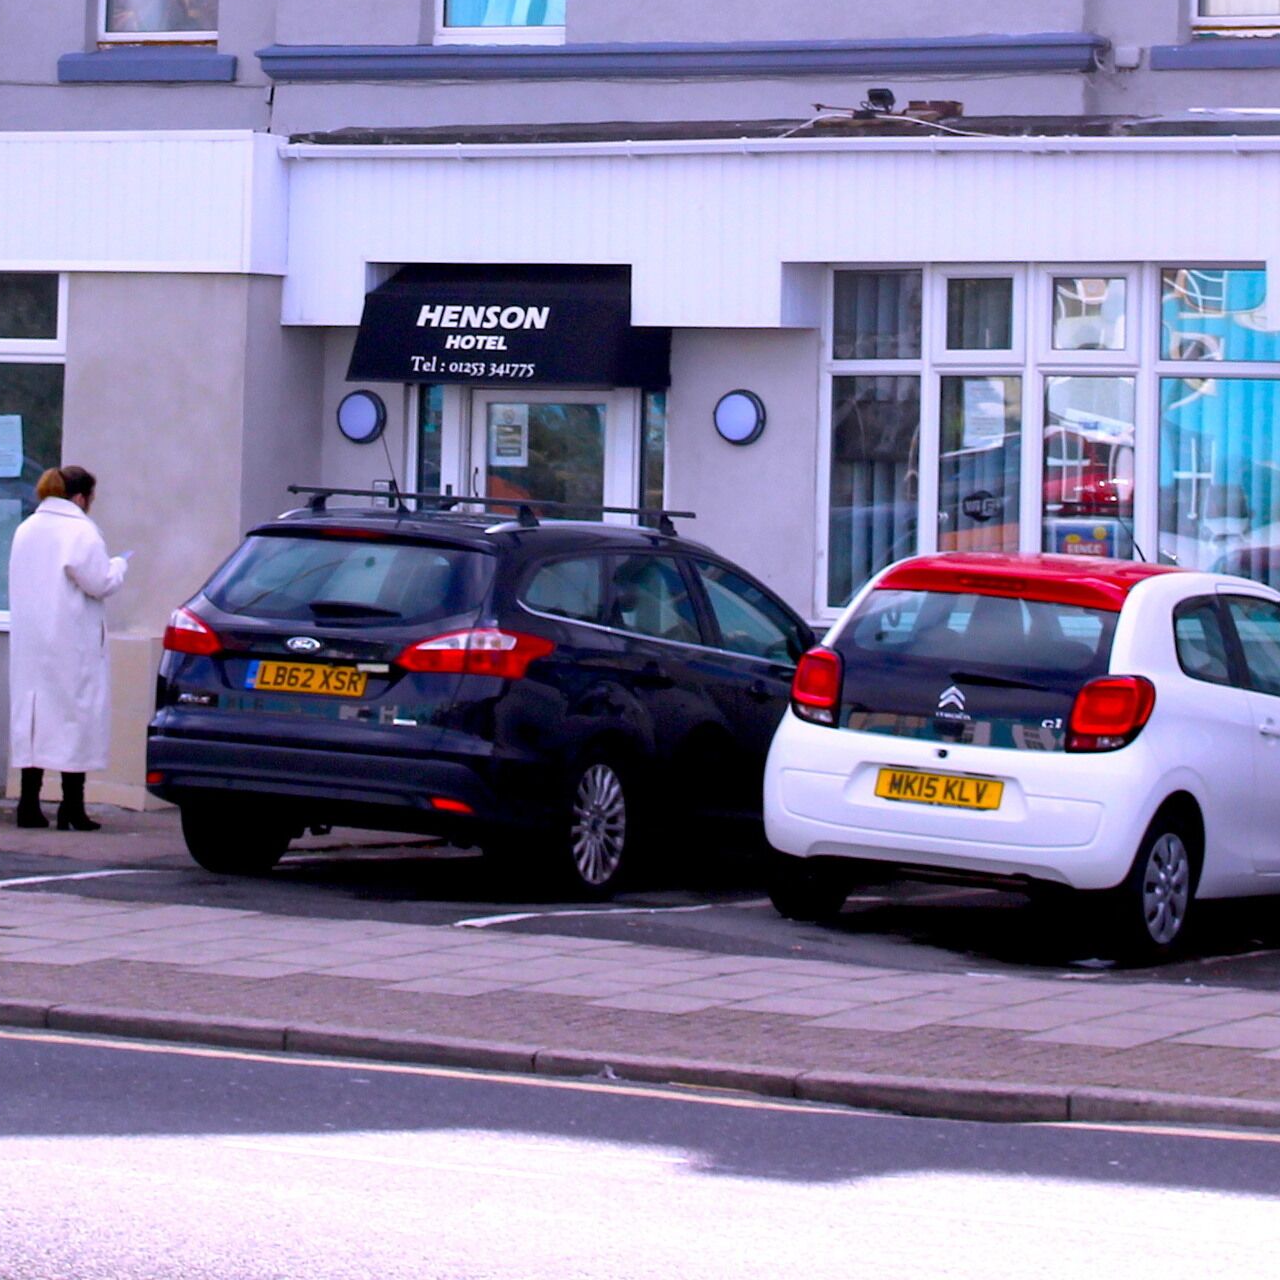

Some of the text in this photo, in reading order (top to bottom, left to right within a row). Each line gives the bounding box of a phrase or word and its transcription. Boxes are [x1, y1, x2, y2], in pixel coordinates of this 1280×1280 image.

[416, 305, 550, 329] HENSON
[445, 335, 508, 350] HOTEL
[449, 362, 486, 376] 01253
[488, 363, 535, 377] 341775
[258, 665, 363, 692] LB62 XSR
[888, 773, 989, 804] MK15 KLV
